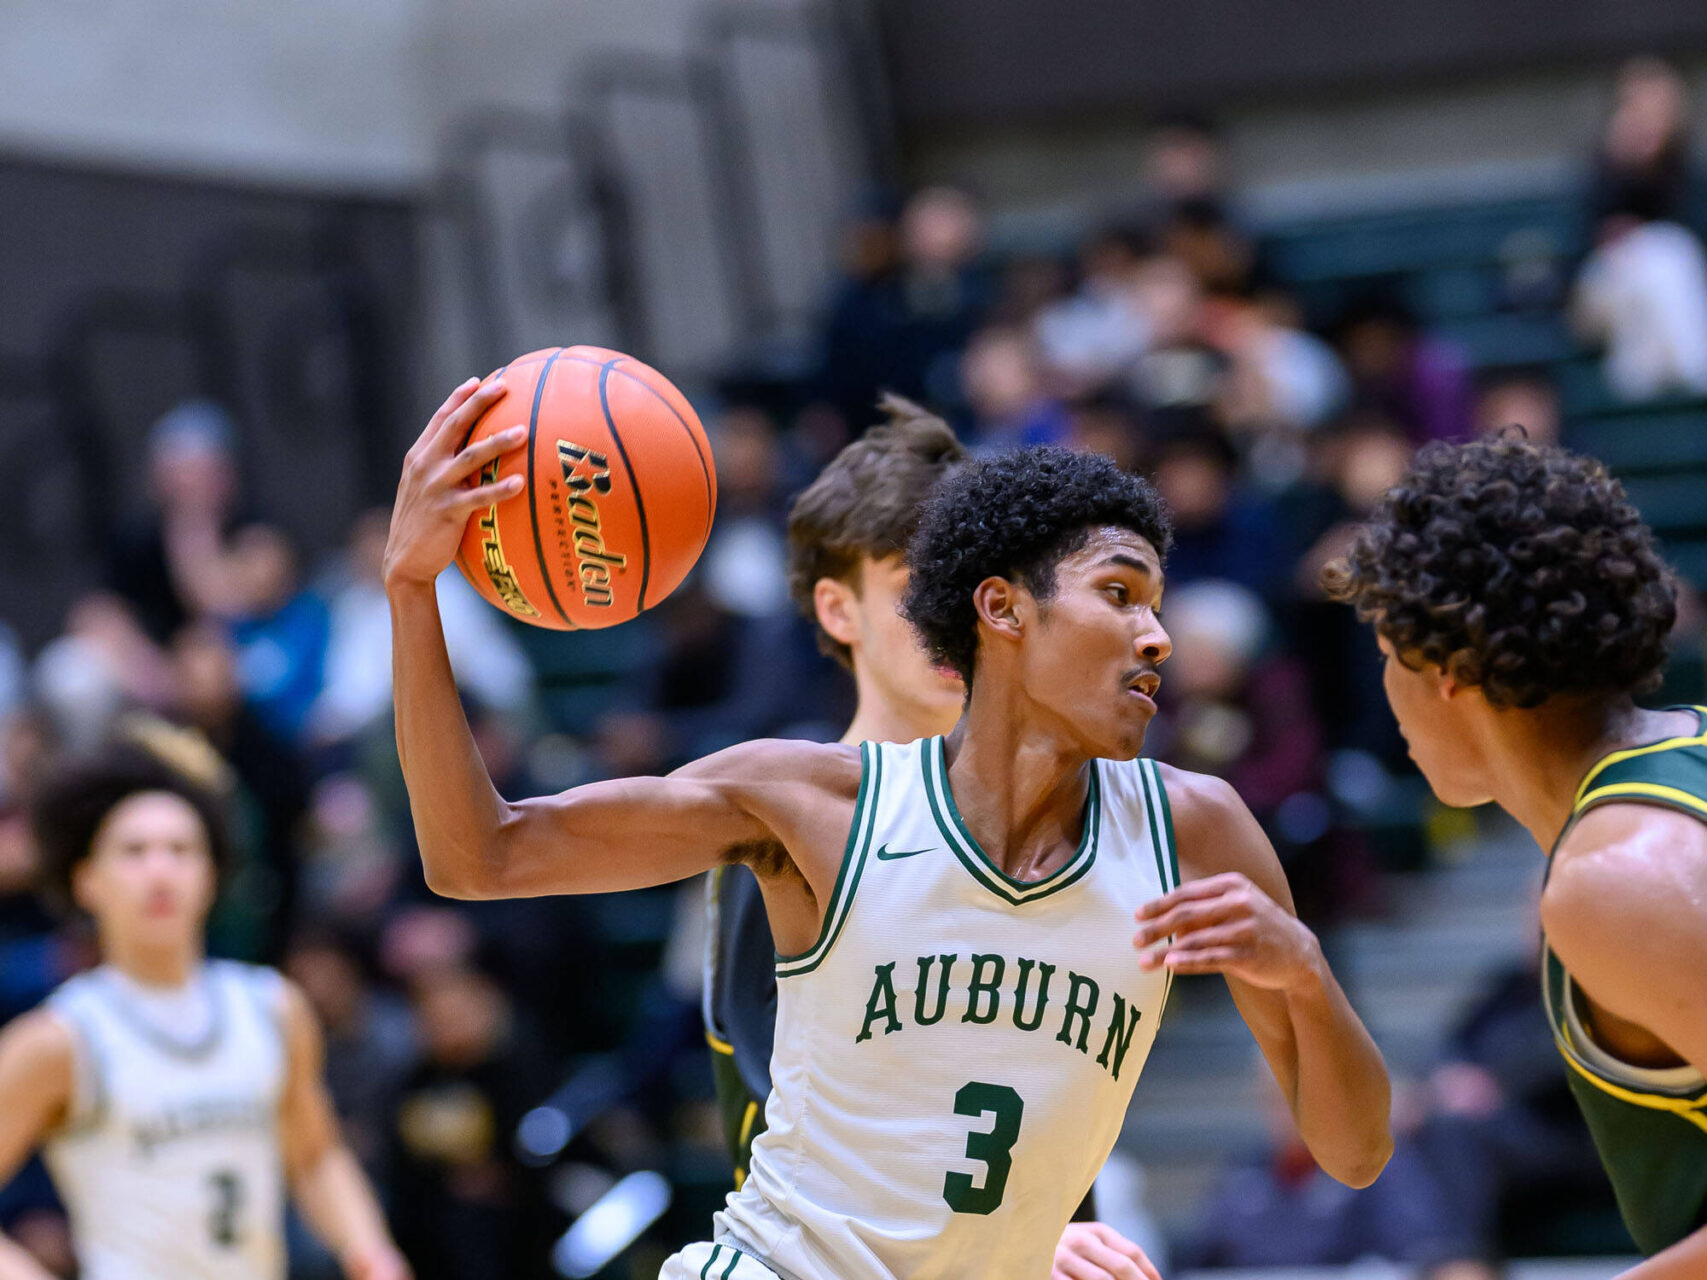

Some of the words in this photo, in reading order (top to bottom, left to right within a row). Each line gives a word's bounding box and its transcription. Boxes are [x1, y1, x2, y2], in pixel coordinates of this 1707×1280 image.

[556, 438, 628, 607] Baden
[855, 953, 1142, 1082] AUBURN
[942, 1081, 1025, 1216] 3
